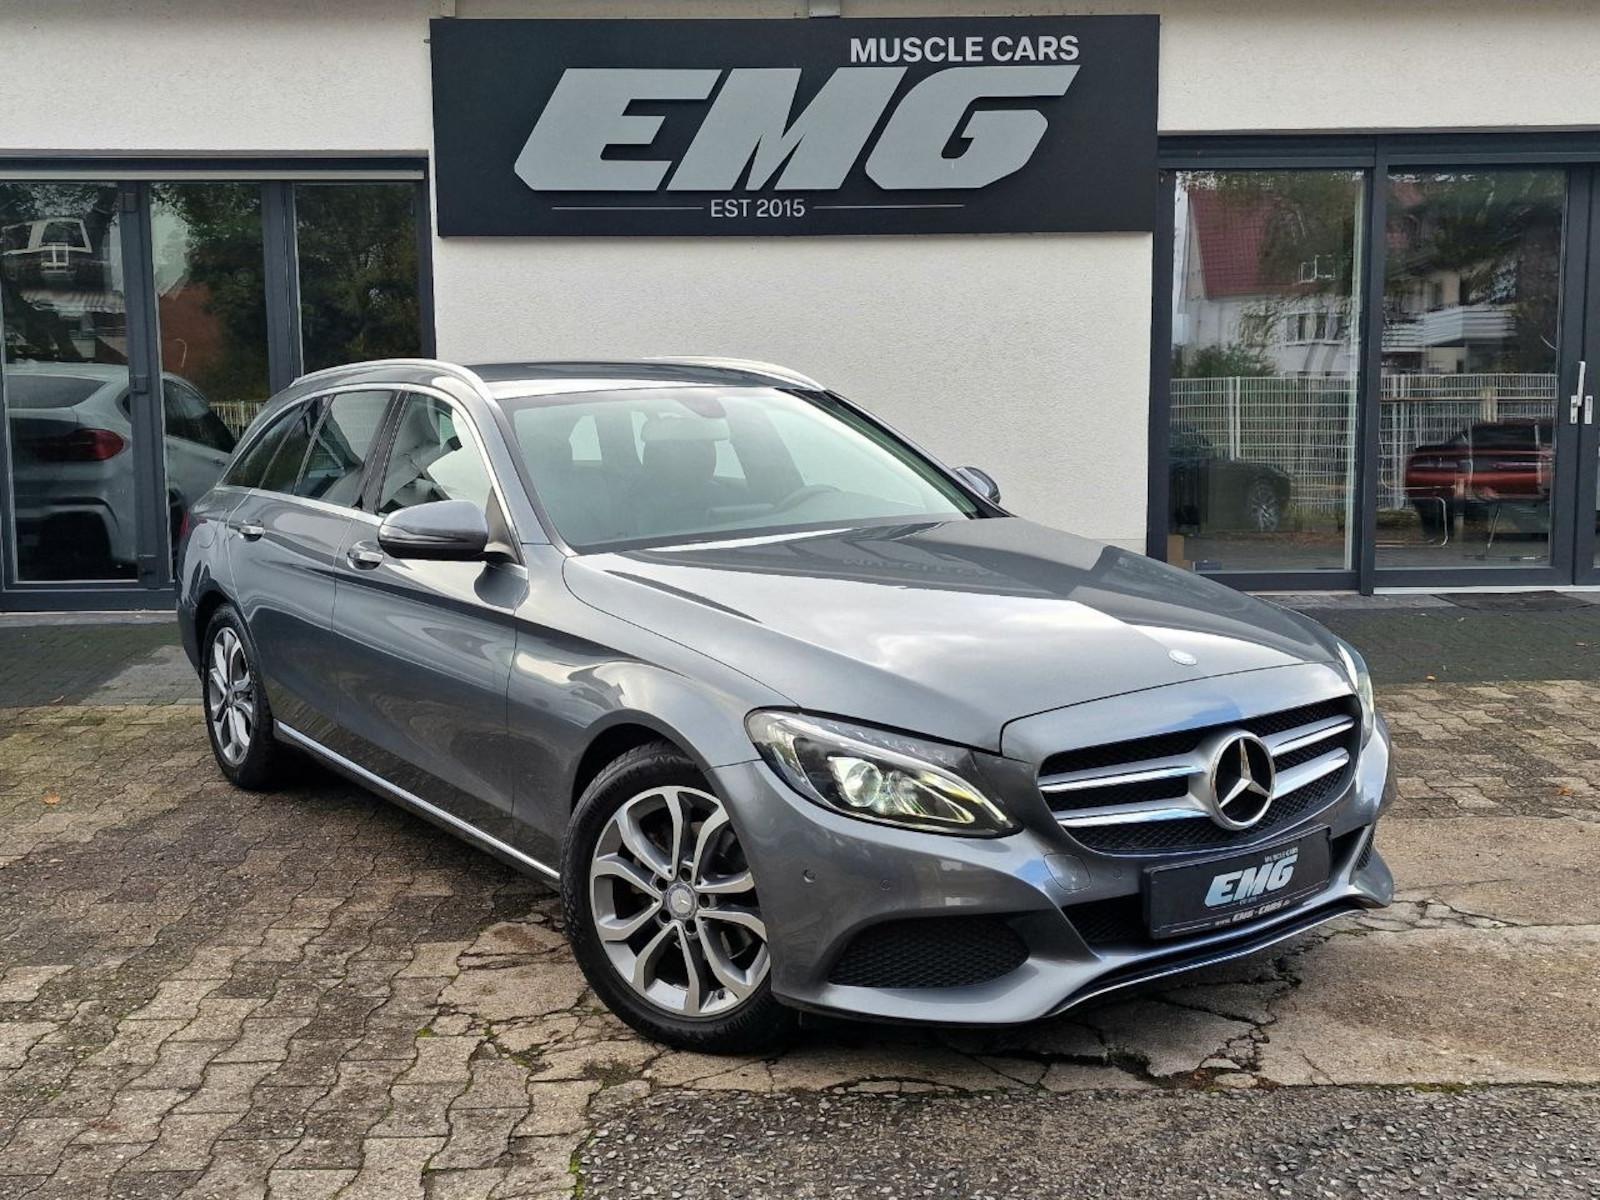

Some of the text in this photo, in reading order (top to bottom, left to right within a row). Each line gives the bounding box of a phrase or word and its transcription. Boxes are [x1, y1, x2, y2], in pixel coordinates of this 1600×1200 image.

[850, 35, 1080, 63] MUSCLE CARS
[513, 65, 1081, 192] EMG
[710, 198, 806, 218] EST 2015
[1204, 854, 1298, 907] EMG
